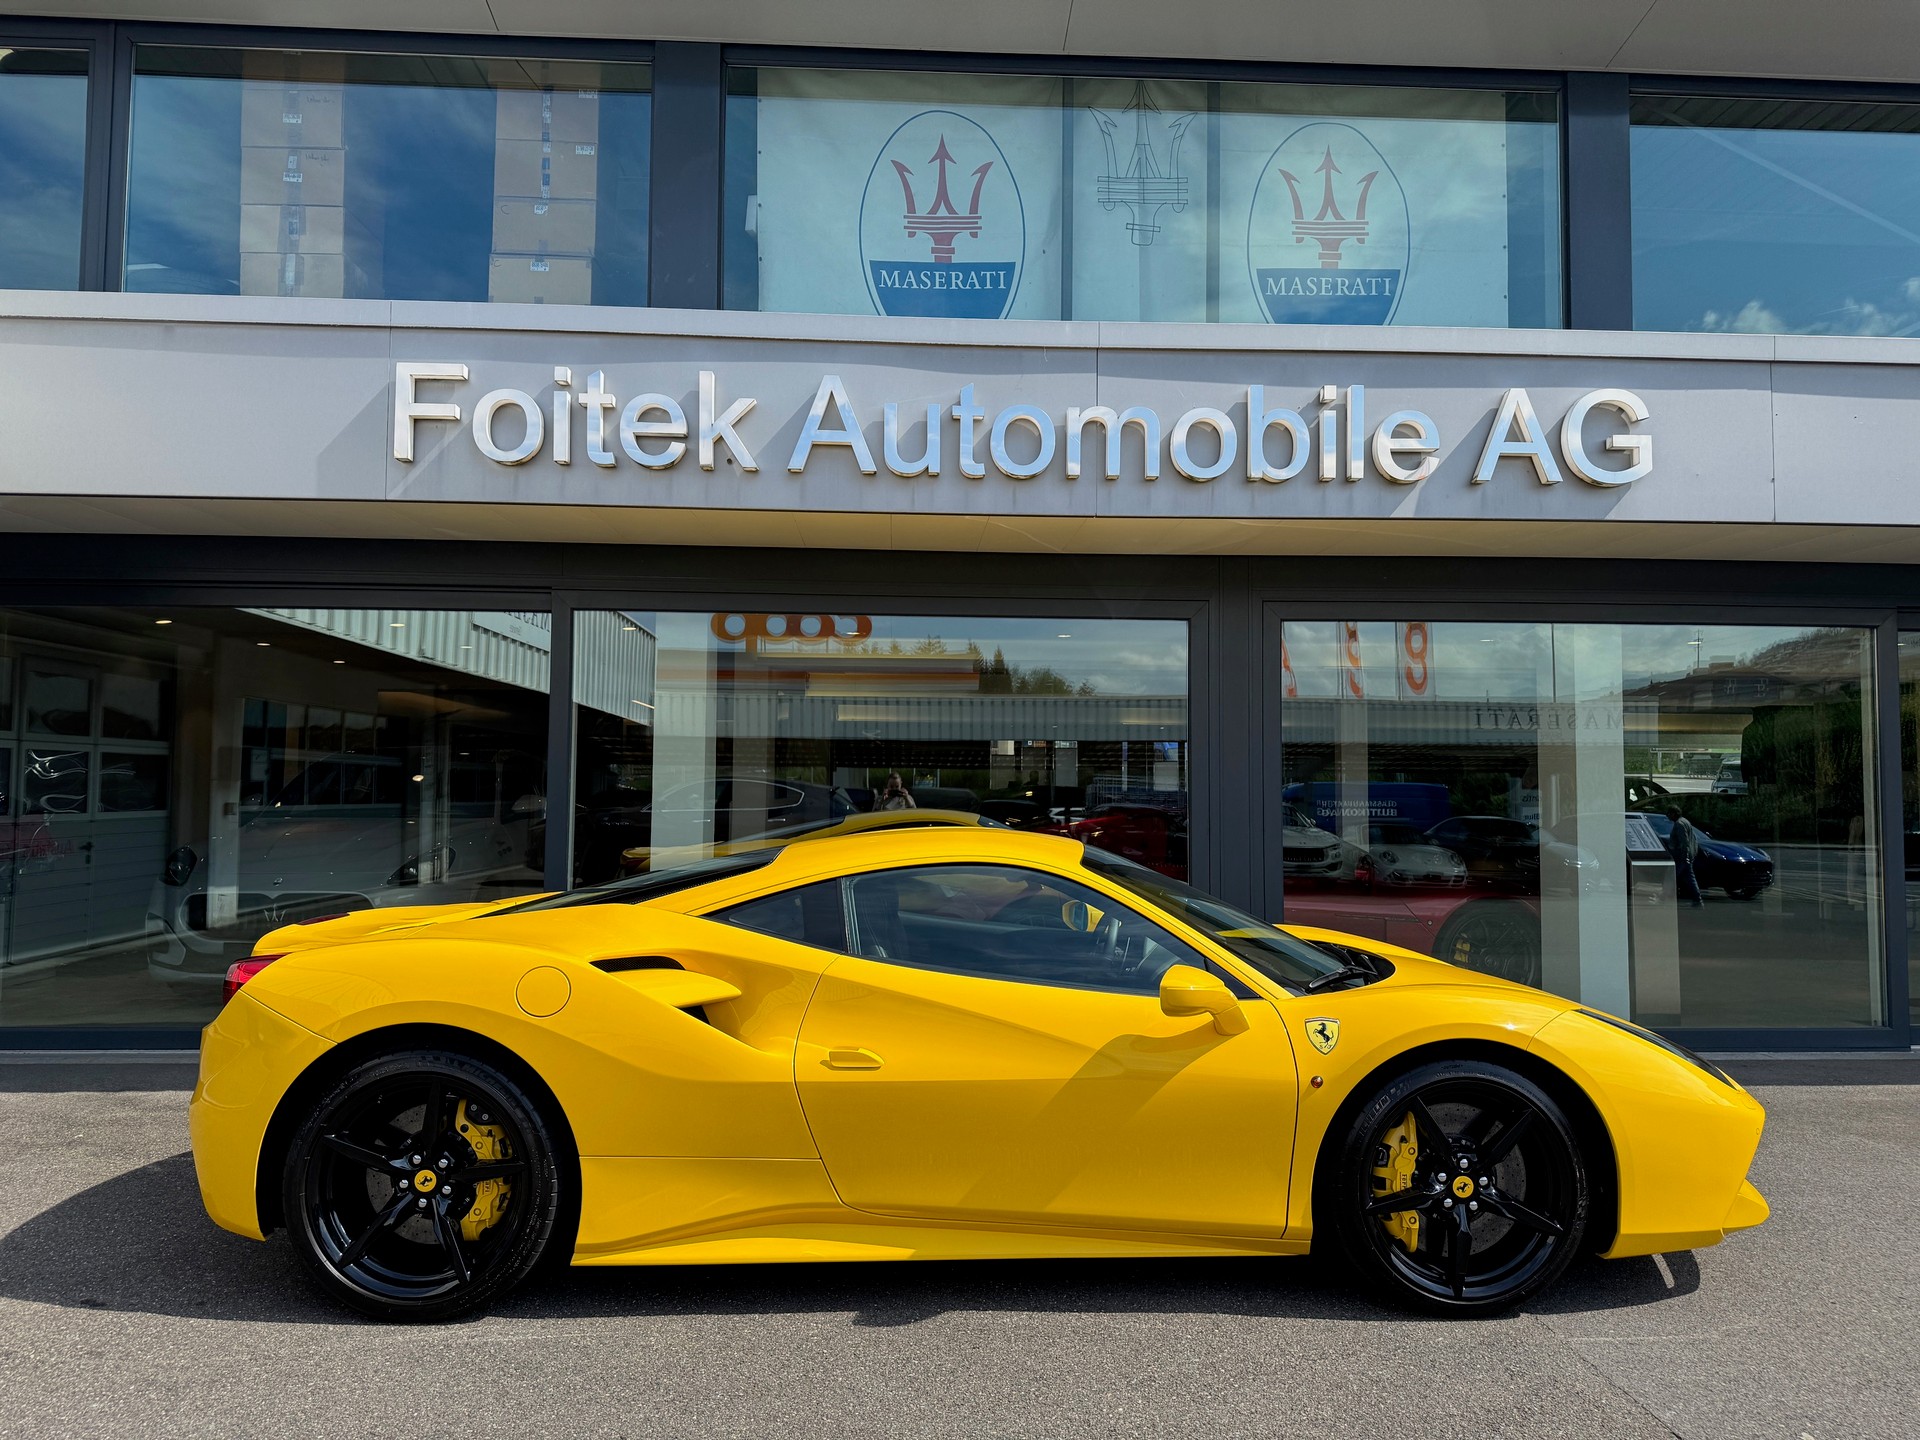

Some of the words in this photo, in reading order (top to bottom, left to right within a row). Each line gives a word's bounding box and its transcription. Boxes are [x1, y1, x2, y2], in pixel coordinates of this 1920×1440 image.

[879, 269, 1007, 290] MASERATI
[1265, 276, 1392, 296] MASERATI
[394, 362, 760, 472] Foitek
[787, 374, 1440, 484] Automobile
[1471, 387, 1653, 487] AG
